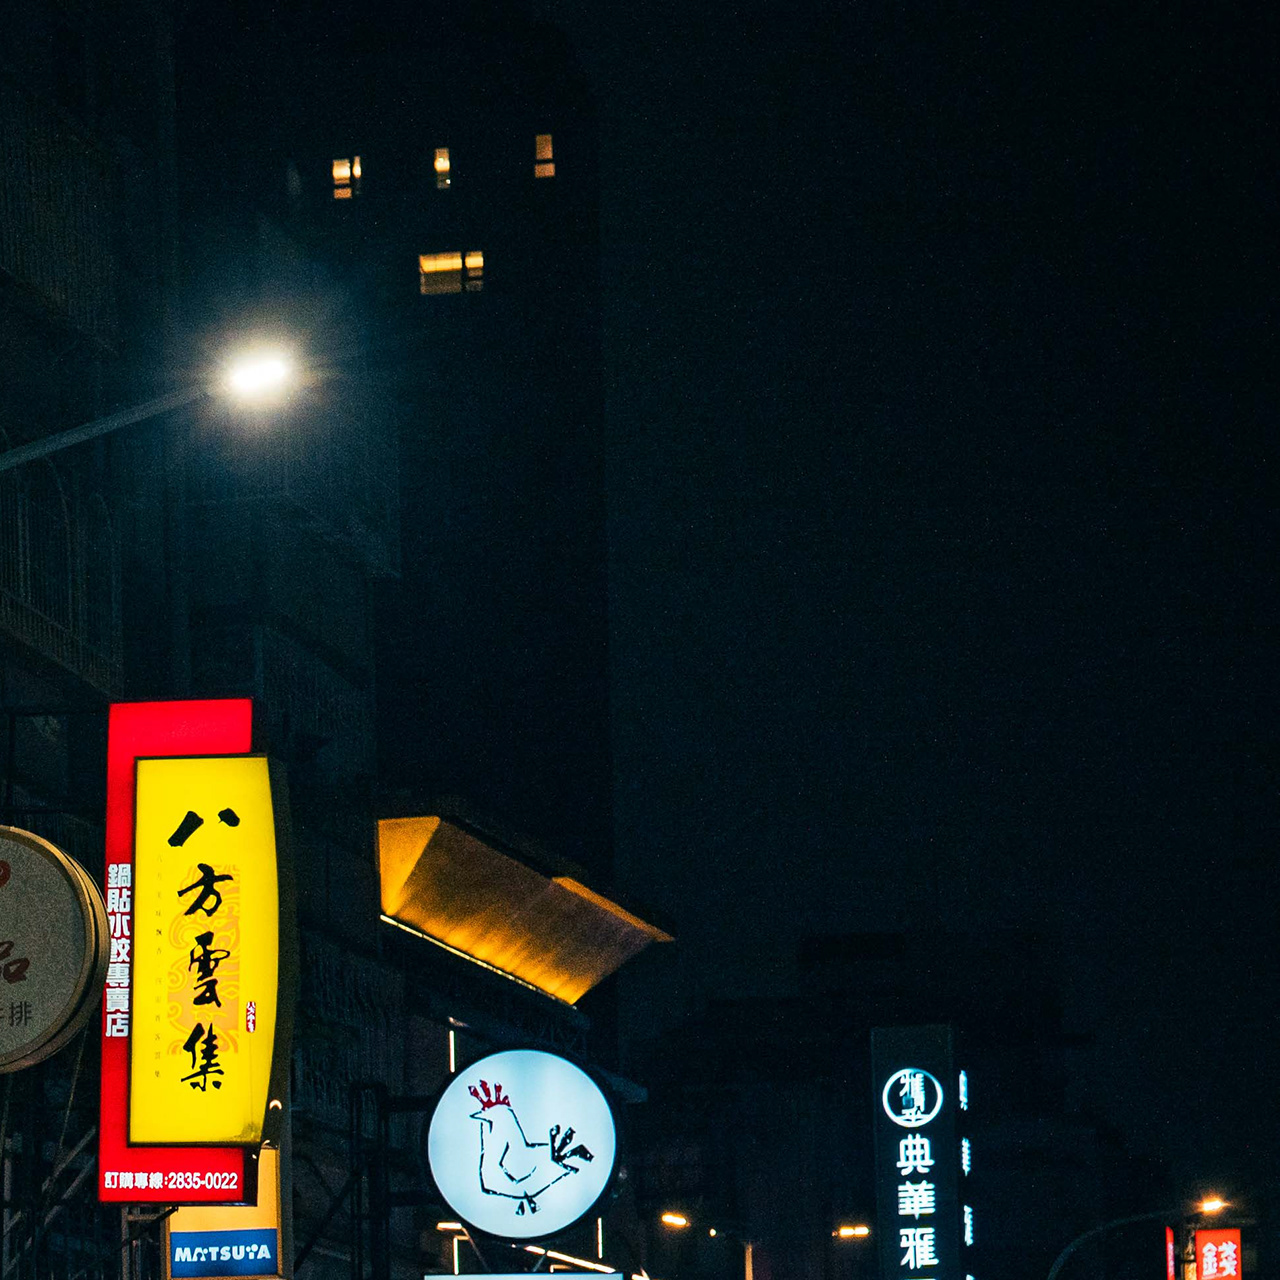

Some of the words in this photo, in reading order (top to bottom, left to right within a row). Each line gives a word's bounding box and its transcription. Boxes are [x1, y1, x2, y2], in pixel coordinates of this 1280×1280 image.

[105, 863, 132, 1037] 鍋貼水餃專賣店
[167, 808, 240, 1093] 八方雲集
[174, 1243, 272, 1262] MATSUYA
